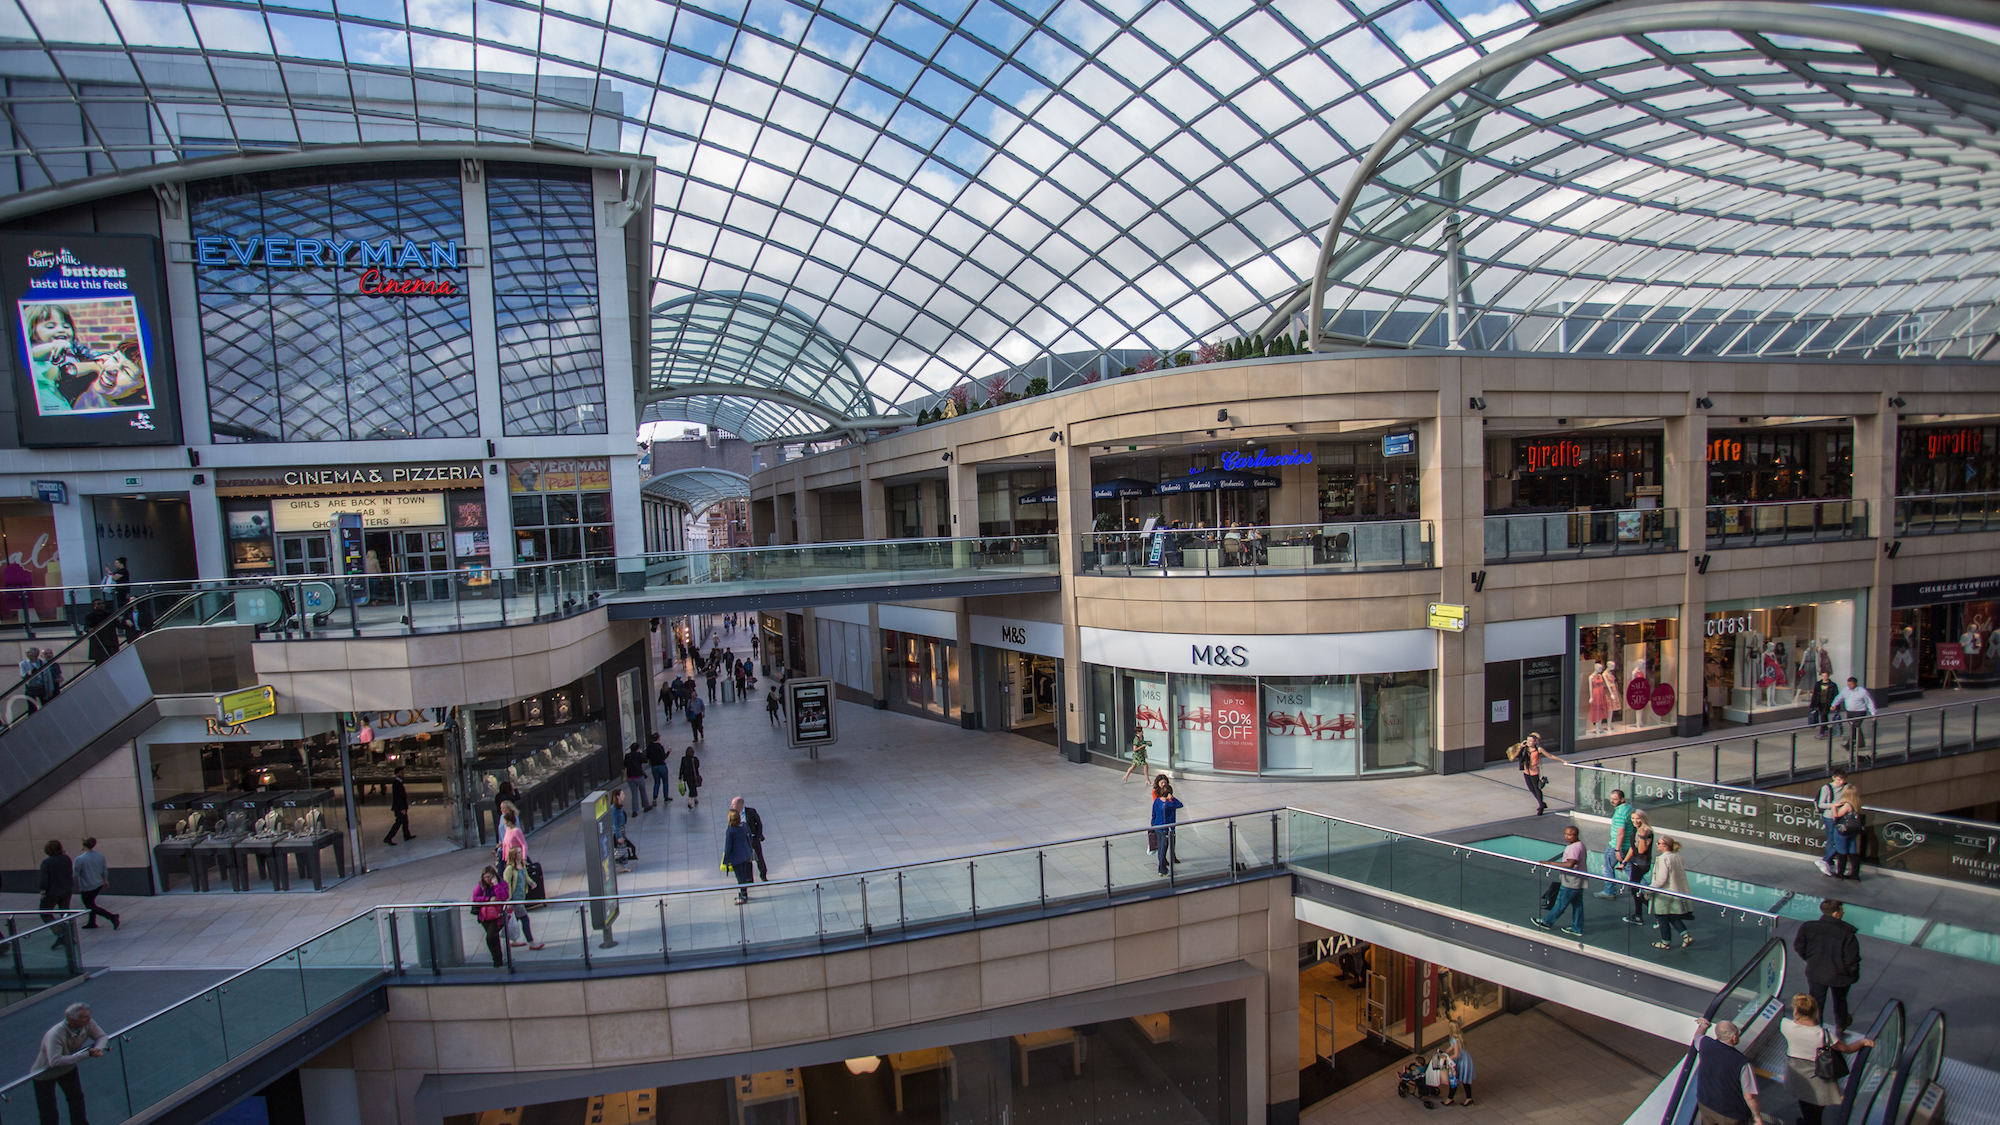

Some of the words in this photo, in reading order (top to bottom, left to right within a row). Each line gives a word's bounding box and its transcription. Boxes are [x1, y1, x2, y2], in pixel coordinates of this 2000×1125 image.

[197, 236, 458, 269] EVERYMAN
[28, 255, 55, 269] Dairy
[61, 265, 127, 278] buttons
[30, 278, 58, 289] taste
[60, 279, 80, 289] like
[81, 280, 102, 289] this
[103, 280, 128, 290] feels
[359, 269, 456, 295] Cinema
[1706, 439, 1741, 462] affe
[1929, 429, 1981, 459] giraffe
[1528, 440, 1580, 472] giraffe
[285, 469, 365, 486] CINEMA
[368, 469, 383, 483] &
[393, 465, 482, 482] PIZZERIA
[530, 461, 607, 473] EVERYMAN
[546, 473, 608, 490] Pizzeria
[290, 500, 320, 509] GIRLS
[328, 499, 347, 507] ARE
[351, 498, 376, 507] BACK
[397, 496, 425, 505] TOWN
[1919, 585, 1957, 594] CHARLES
[1707, 612, 1752, 637] coast
[1002, 625, 1026, 644] M&S
[1192, 644, 1247, 667] M&S
[1142, 690, 1161, 701] M&S
[1276, 695, 1303, 705] M&S
[378, 708, 429, 728] ROX
[1218, 710, 1251, 725] 50%
[1218, 725, 1252, 739] OFF
[1635, 784, 1682, 802] coast
[1697, 797, 1757, 817] NERO
[1773, 803, 1823, 820] TOPSH
[1689, 819, 1765, 838] TYRWHITT
[1700, 815, 1754, 829] CHARLES
[1769, 831, 1801, 845] RIVER
[1804, 838, 1828, 849] ISLA
[1961, 837, 1980, 846] THE
[1968, 868, 1986, 877] THE
